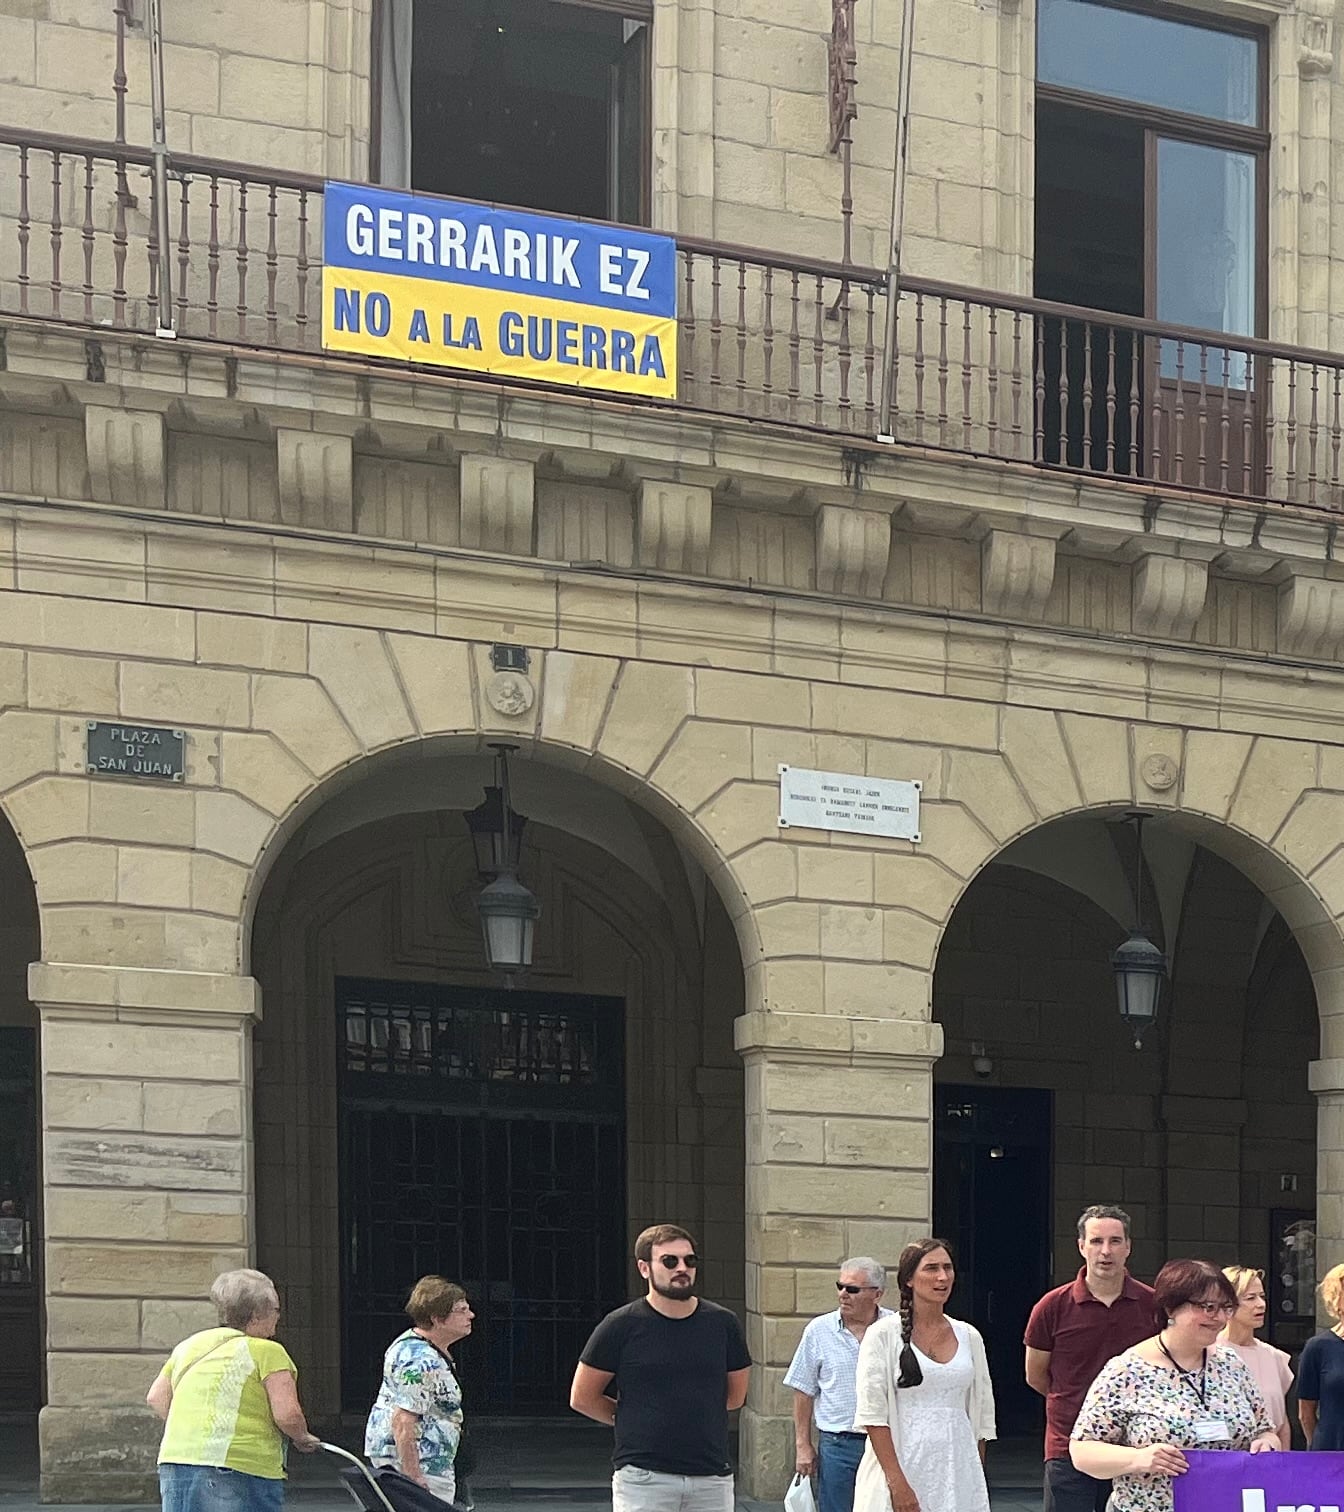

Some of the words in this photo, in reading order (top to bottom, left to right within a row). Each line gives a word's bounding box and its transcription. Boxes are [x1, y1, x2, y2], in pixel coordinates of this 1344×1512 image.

[345, 203, 583, 289] GERRARIK
[599, 243, 651, 300] EZ
[333, 287, 391, 338] NO
[408, 309, 431, 344] A
[443, 313, 482, 352] LA
[499, 311, 666, 379] GUERRA
[110, 728, 162, 745] PLAZA
[125, 744, 145, 757] DE
[98, 756, 127, 770] SAN
[132, 760, 172, 775] JUAN
